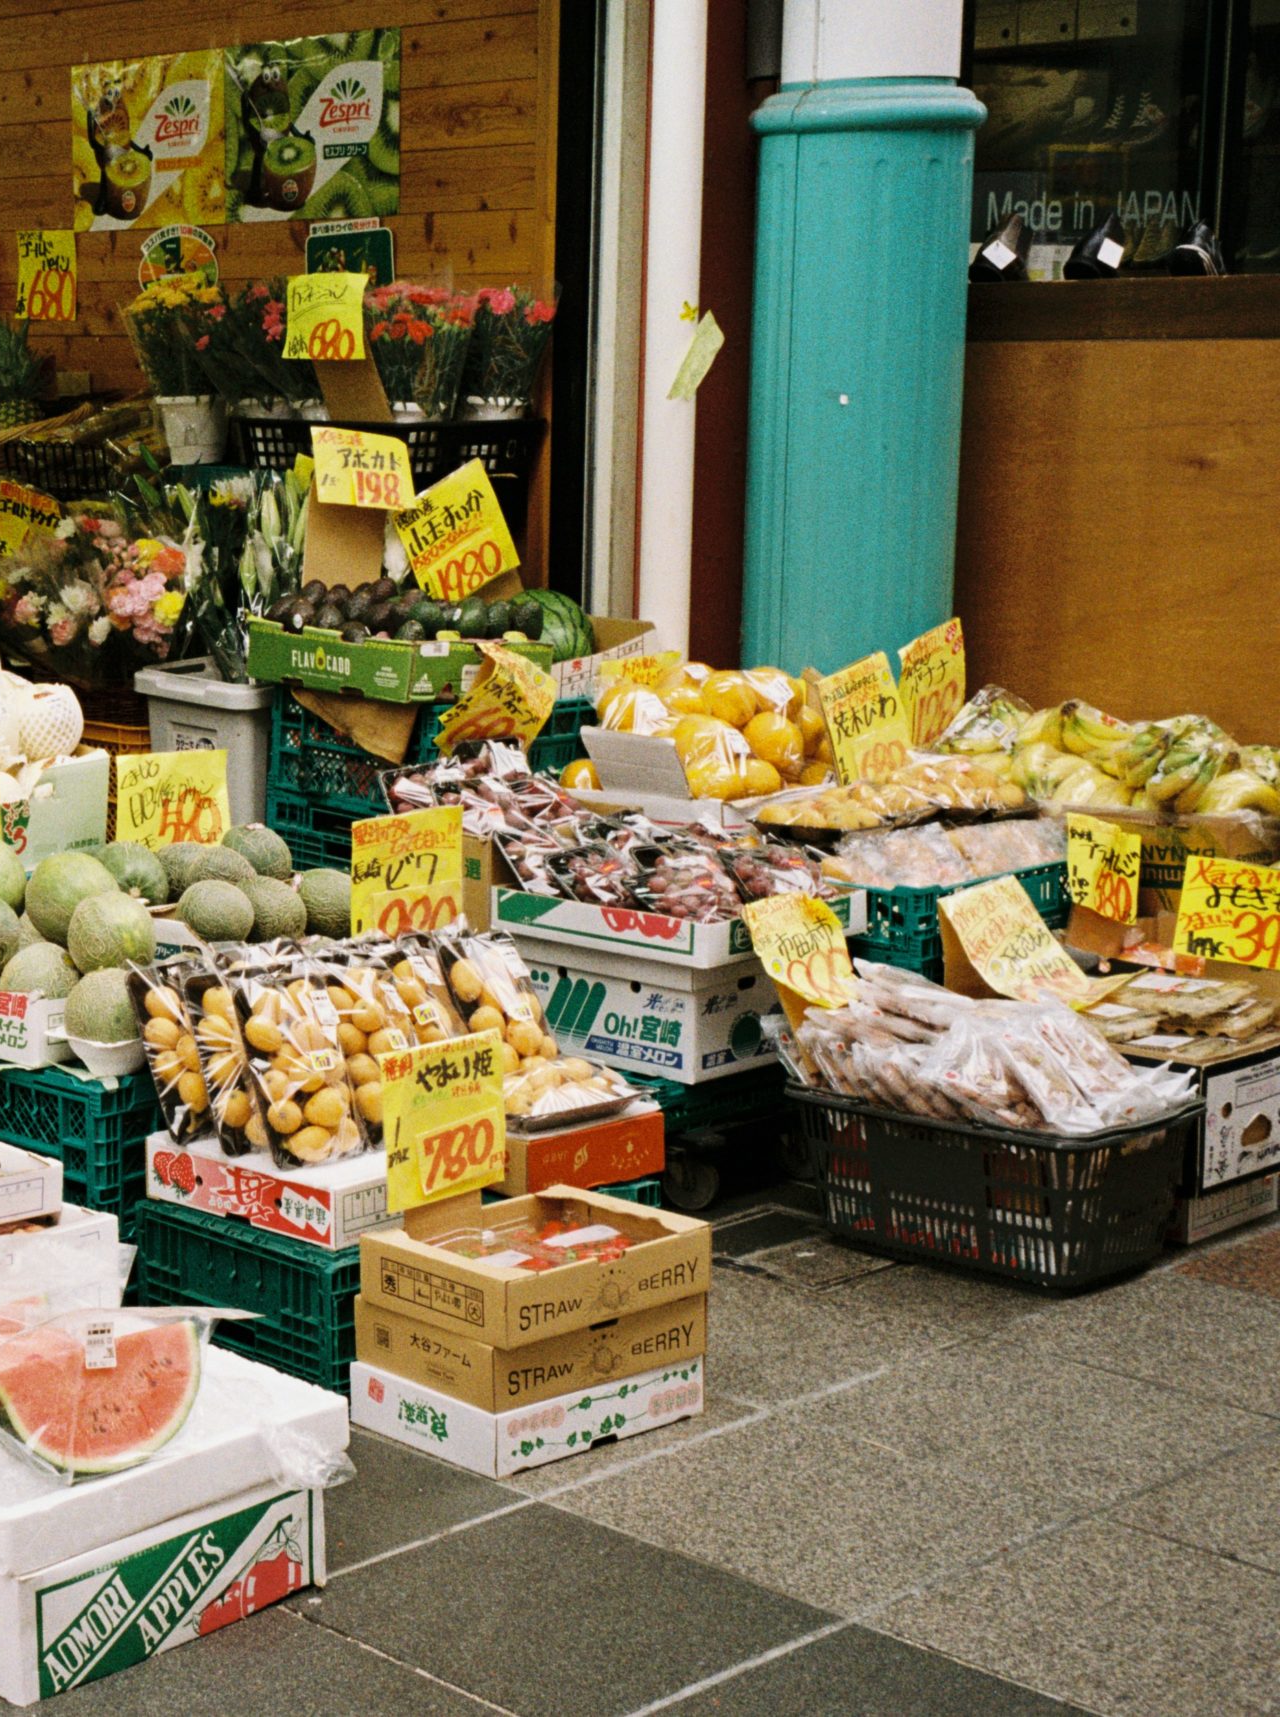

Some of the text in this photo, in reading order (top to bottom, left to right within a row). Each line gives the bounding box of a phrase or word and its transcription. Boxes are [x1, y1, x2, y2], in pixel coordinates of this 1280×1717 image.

[154, 114, 201, 143] Zespri
[320, 97, 372, 128] Zespri
[986, 189, 1202, 232] Made in JAPAN
[28, 269, 76, 320] 680
[308, 318, 355, 360] 680
[338, 447, 402, 470] アボカド
[355, 470, 401, 505] 198
[436, 540, 504, 602] 1980
[614, 1041, 680, 1068] 温室メロン
[422, 1118, 496, 1191] 780
[518, 1257, 699, 1332] STRAW BERRY
[409, 1332, 472, 1369] 大谷ファーム
[507, 1321, 695, 1396] STRAW BERRY
[136, 1529, 225, 1656] APPLES
[44, 1575, 135, 1694] AOMORI
